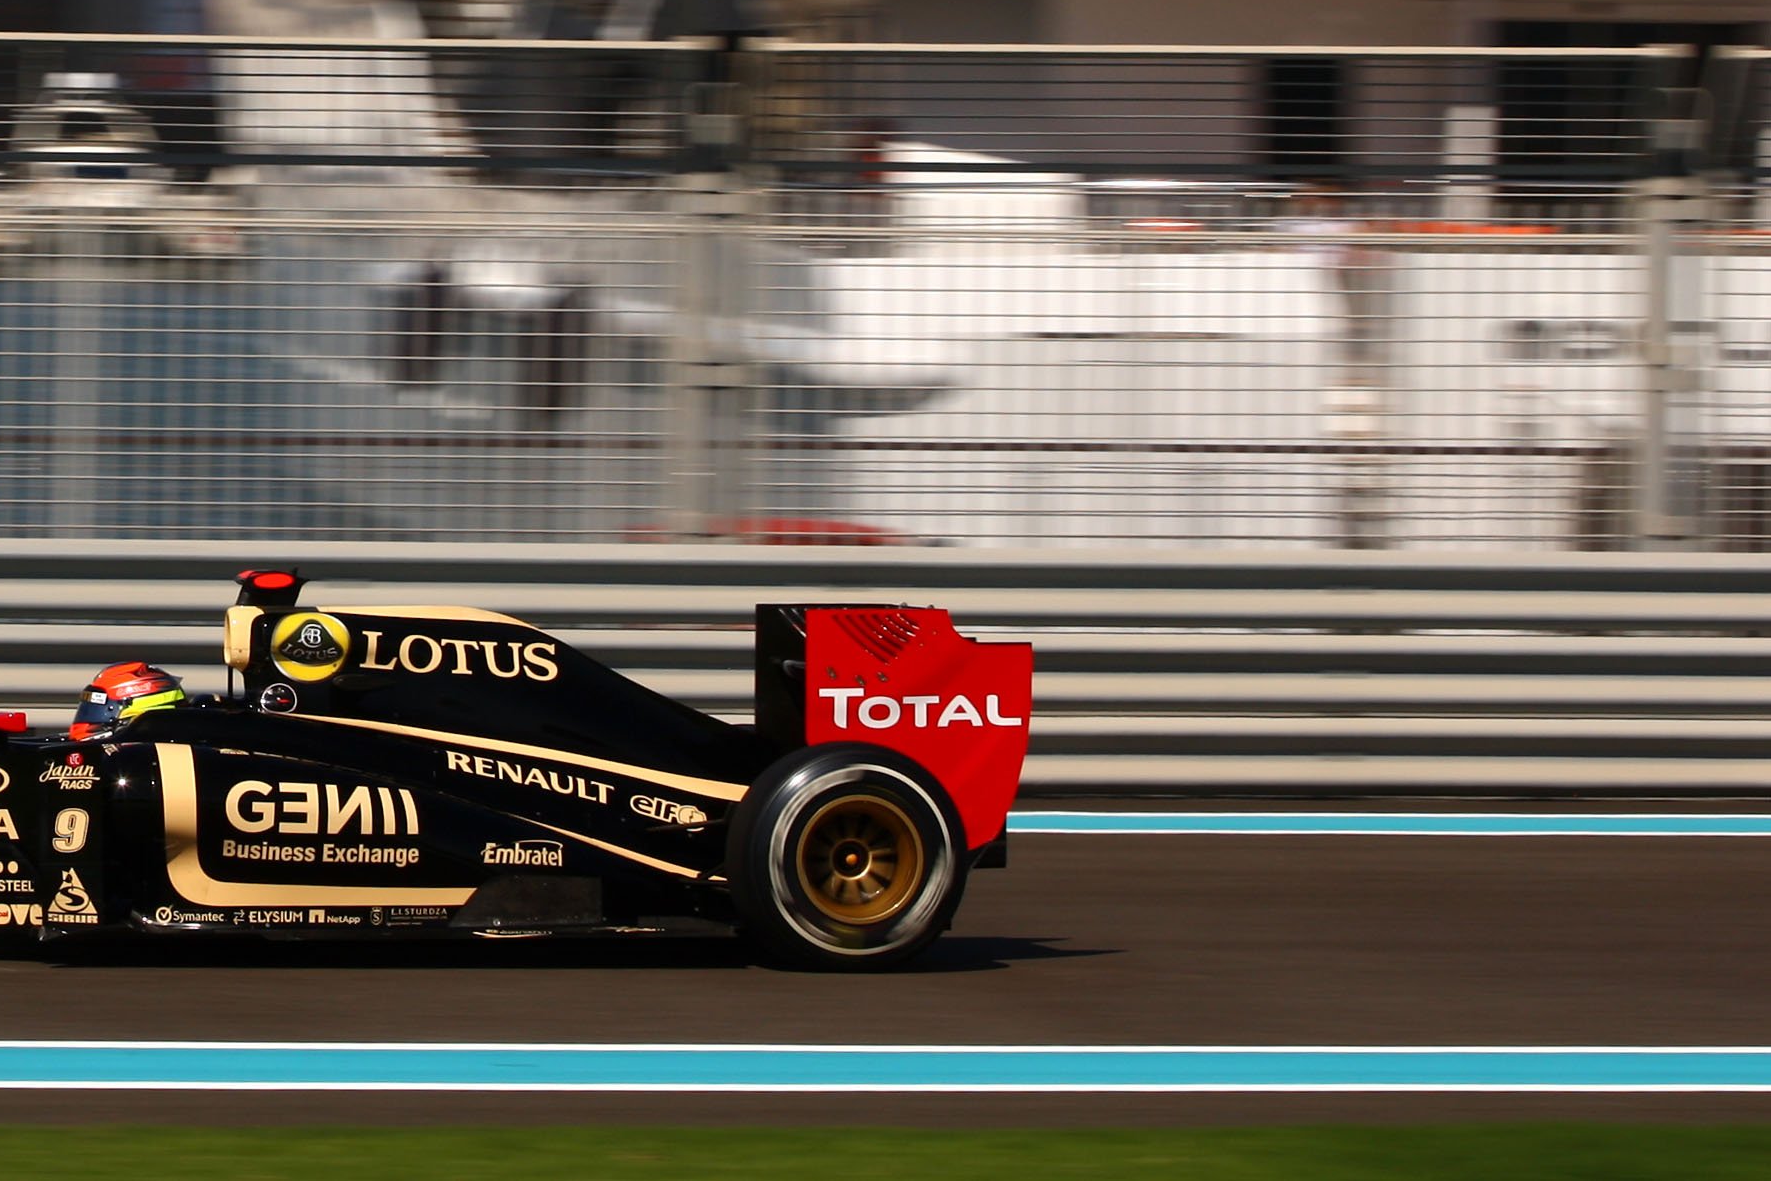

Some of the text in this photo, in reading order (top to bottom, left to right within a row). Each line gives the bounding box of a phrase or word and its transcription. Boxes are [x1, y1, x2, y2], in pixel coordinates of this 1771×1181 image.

[281, 642, 338, 660] LOTUS
[359, 630, 559, 682] LOTUS
[818, 687, 1022, 729] TOTAL
[39, 761, 95, 783] Japan
[60, 779, 93, 790] RAGS
[446, 750, 615, 804] RENAULT
[630, 795, 681, 825] elf
[52, 807, 90, 854] 9
[222, 839, 420, 868] Business Exchange
[481, 840, 564, 867] Embratel
[173, 910, 225, 923] Symantec
[249, 910, 303, 923] ELYSIUM
[327, 916, 361, 925] NetApp
